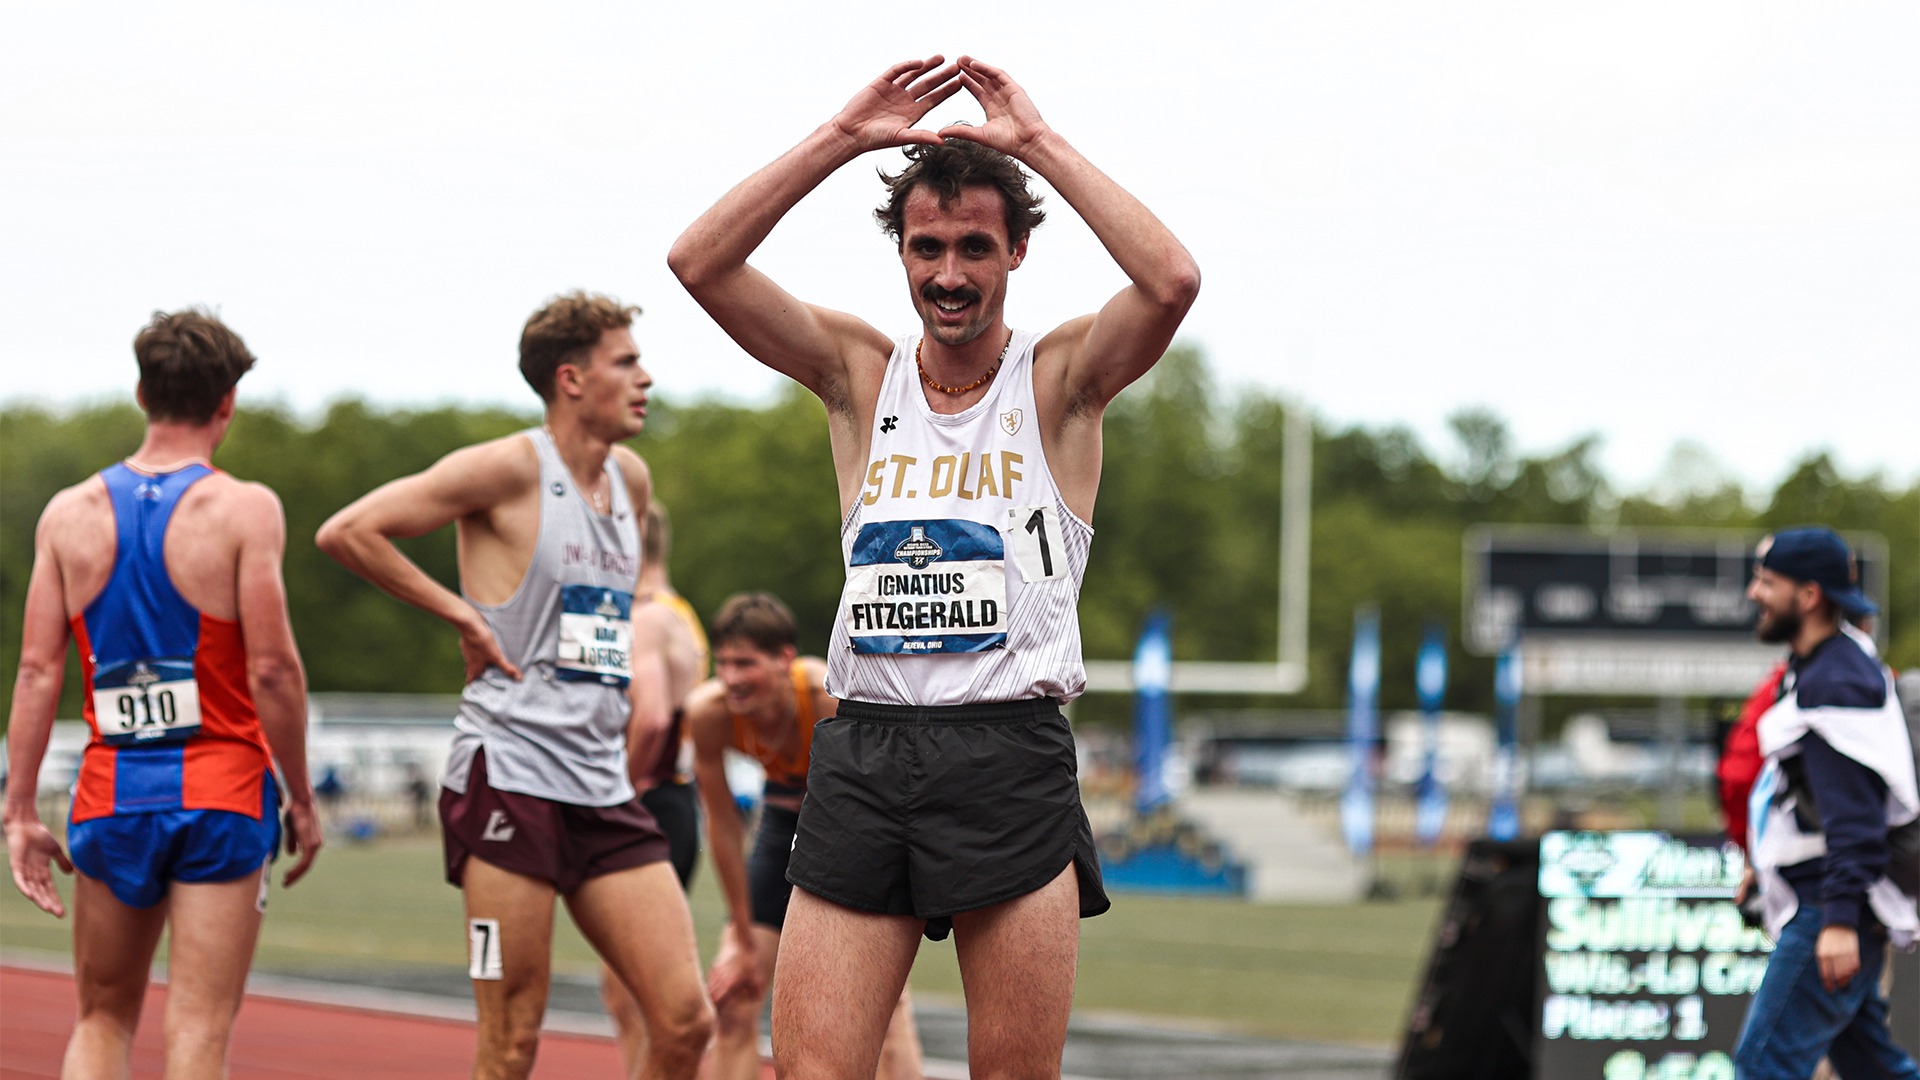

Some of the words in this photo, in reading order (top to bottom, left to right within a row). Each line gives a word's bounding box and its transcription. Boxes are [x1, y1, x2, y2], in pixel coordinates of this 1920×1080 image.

[863, 454, 917, 506] ST.
[929, 450, 1023, 501] OLAF
[896, 549, 941, 557] CHAMPIONSHIPS
[1025, 509, 1054, 577] 1
[877, 572, 965, 597] IGNATIUS
[851, 599, 998, 631] FITZGERALD
[927, 641, 943, 649] OHIO
[118, 690, 177, 729] 910
[1547, 897, 1776, 951] Sulliva
[474, 924, 490, 976] 7
[1672, 995, 1708, 1040] 1
